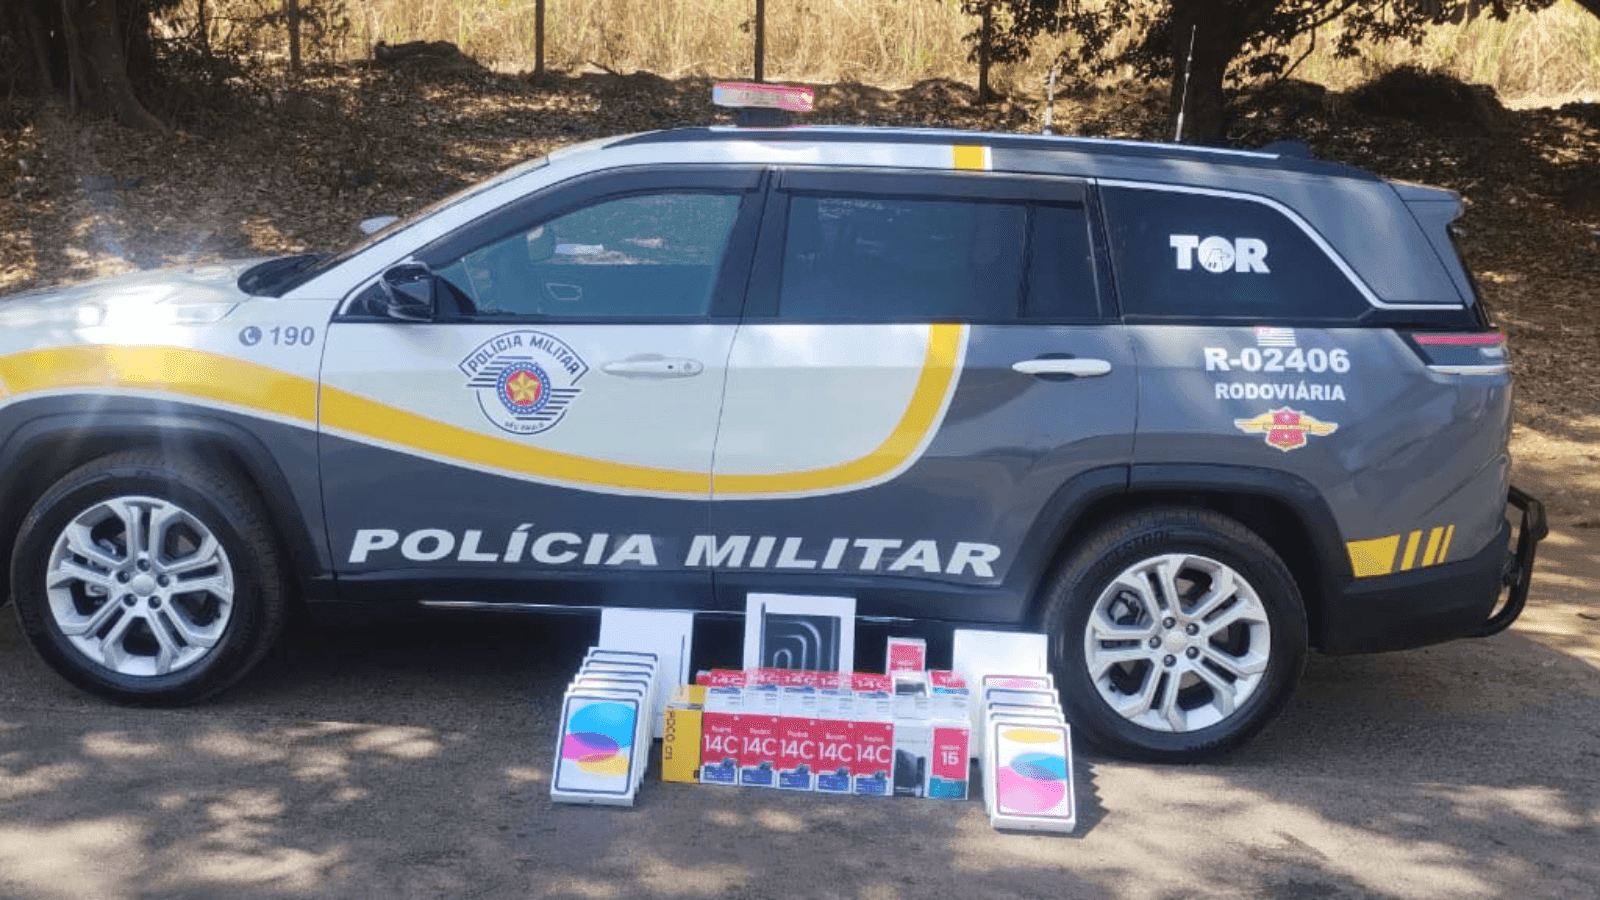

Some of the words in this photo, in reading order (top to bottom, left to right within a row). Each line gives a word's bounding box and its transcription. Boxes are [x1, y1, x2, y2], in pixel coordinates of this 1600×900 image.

[1169, 234, 1271, 274] TOR
[269, 325, 315, 346] 190
[529, 335, 581, 375] MILITAR
[1203, 347, 1351, 373] R-02406
[1214, 380, 1346, 401] RODOVIÁRIA
[347, 523, 659, 566] POLÍCIA
[684, 535, 1001, 578] MILITAR
[665, 710, 676, 742] POCO
[704, 735, 739, 754] 14C
[743, 737, 777, 756] 14C
[780, 738, 815, 760] 14C
[818, 742, 853, 762] 14C
[856, 744, 891, 764] 14C
